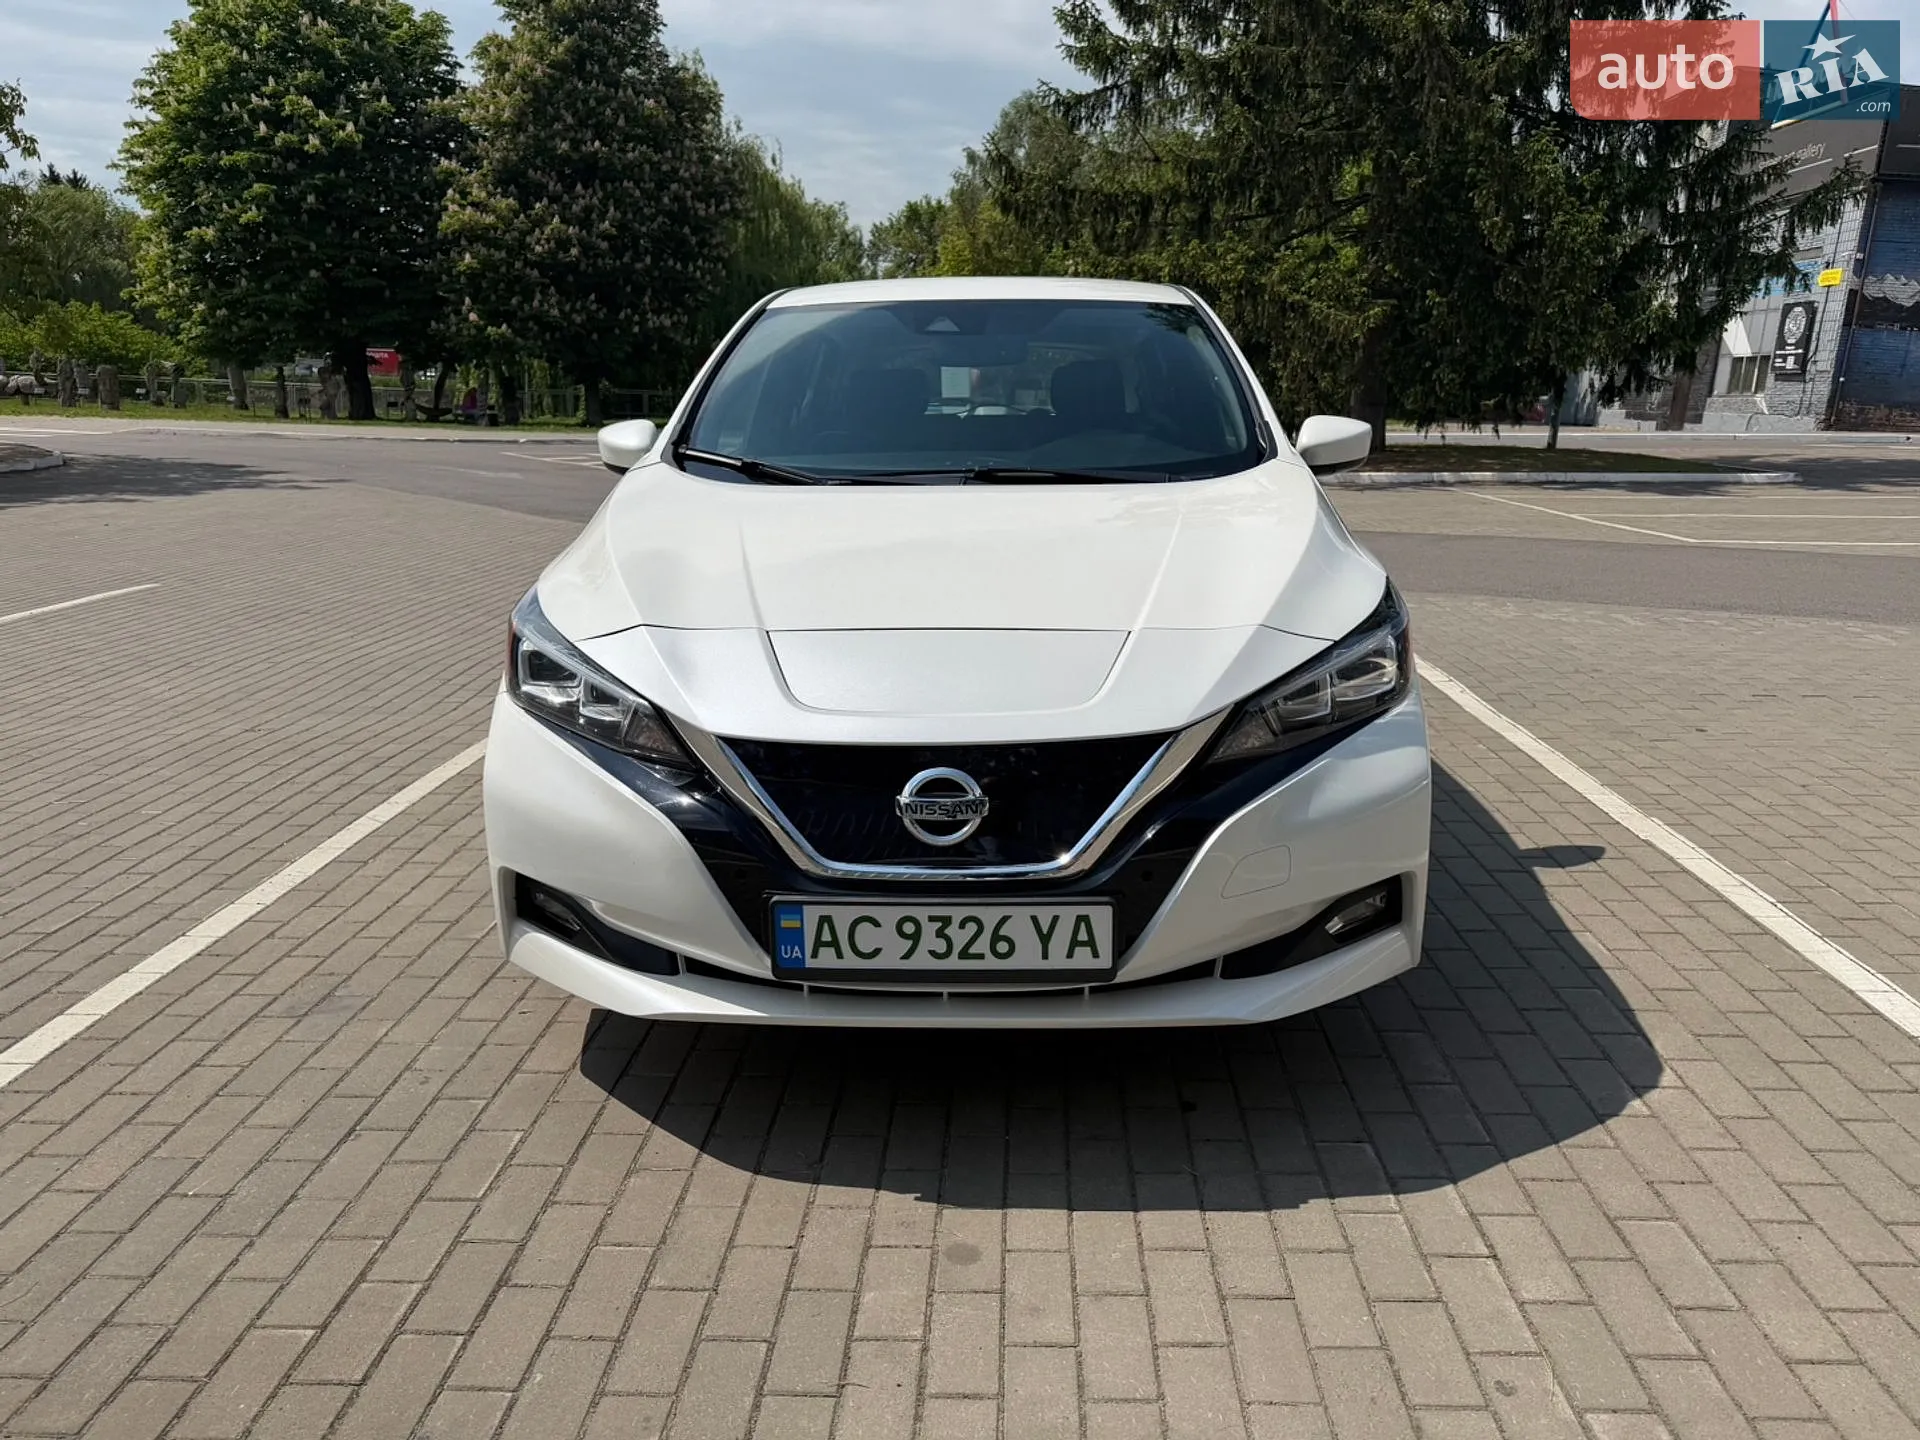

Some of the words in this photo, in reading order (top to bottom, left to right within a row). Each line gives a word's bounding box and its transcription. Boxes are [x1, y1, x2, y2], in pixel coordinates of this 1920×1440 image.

[905, 803, 979, 816] NISSAN
[810, 914, 883, 960] AC
[895, 914, 1016, 960] 9326
[1030, 914, 1100, 960] YA
[781, 945, 803, 959] UA
